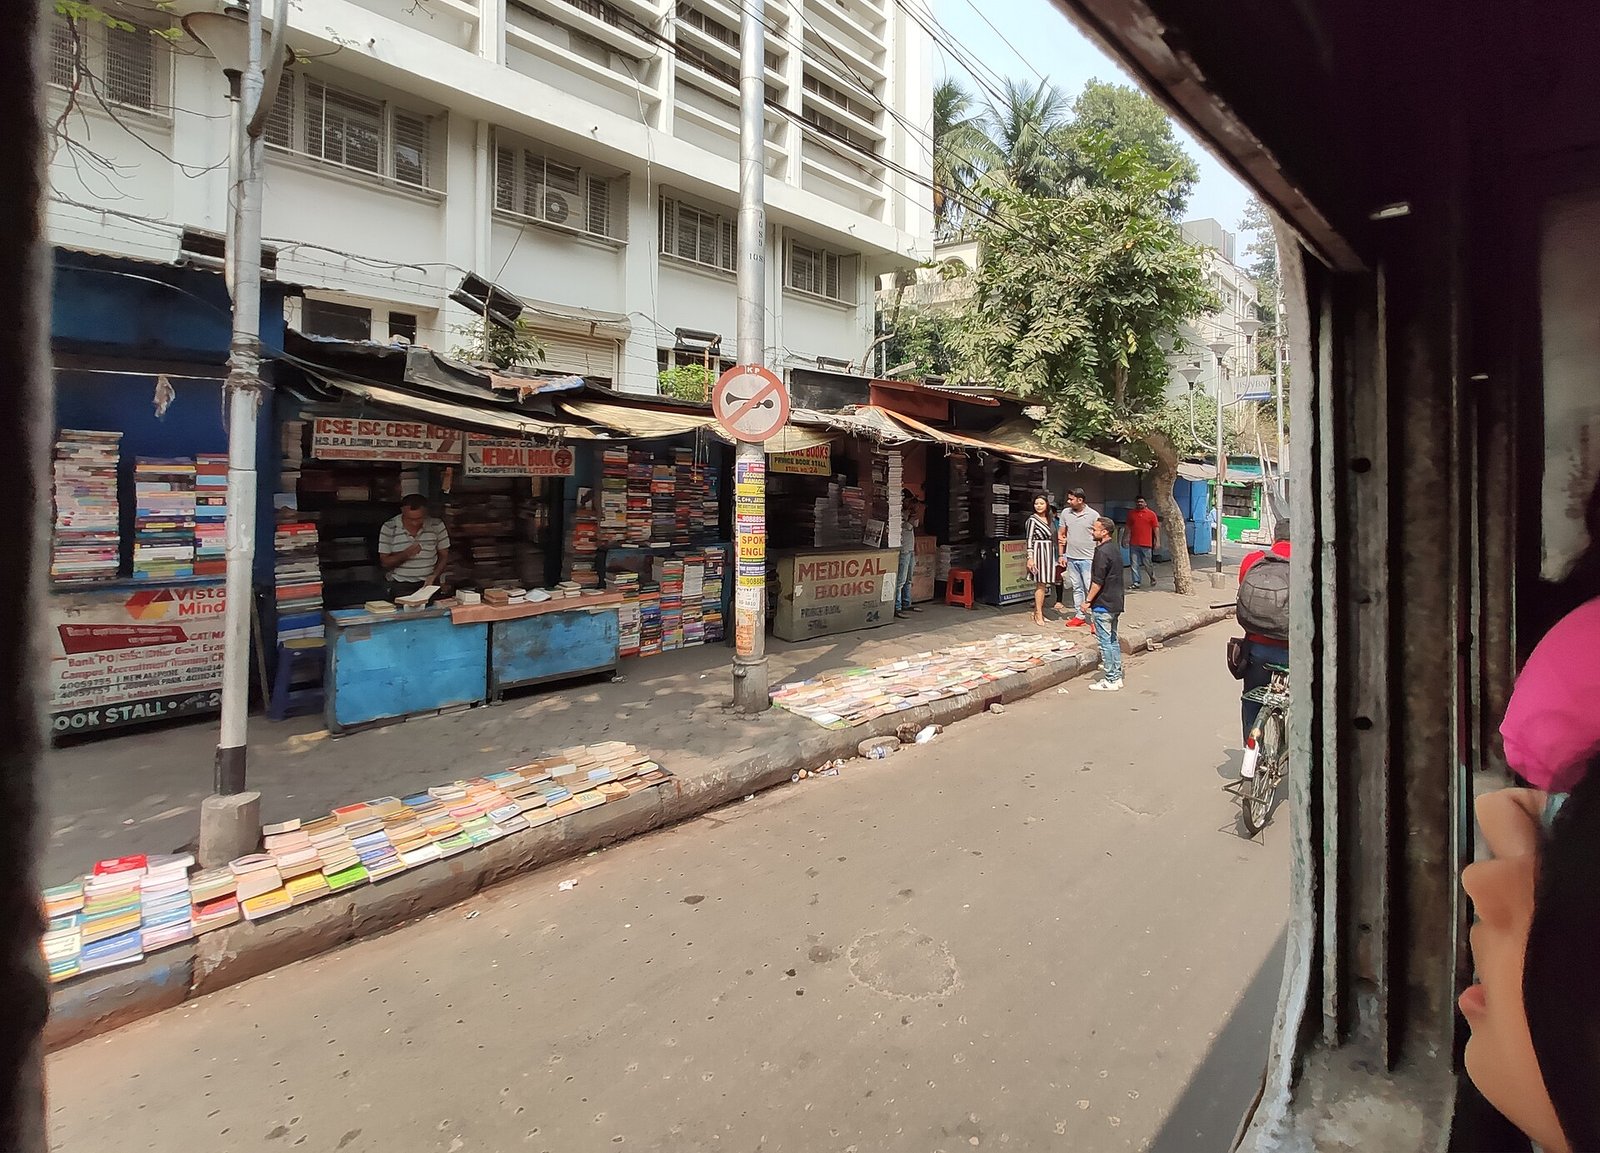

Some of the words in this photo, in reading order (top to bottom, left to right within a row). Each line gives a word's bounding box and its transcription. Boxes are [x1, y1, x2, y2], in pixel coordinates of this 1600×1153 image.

[798, 558, 887, 582] MEDICAL
[175, 587, 227, 601] Vista
[815, 580, 875, 600] BOOKS
[178, 599, 226, 616] Mind
[865, 610, 880, 623] 24
[105, 701, 168, 723] STALL
